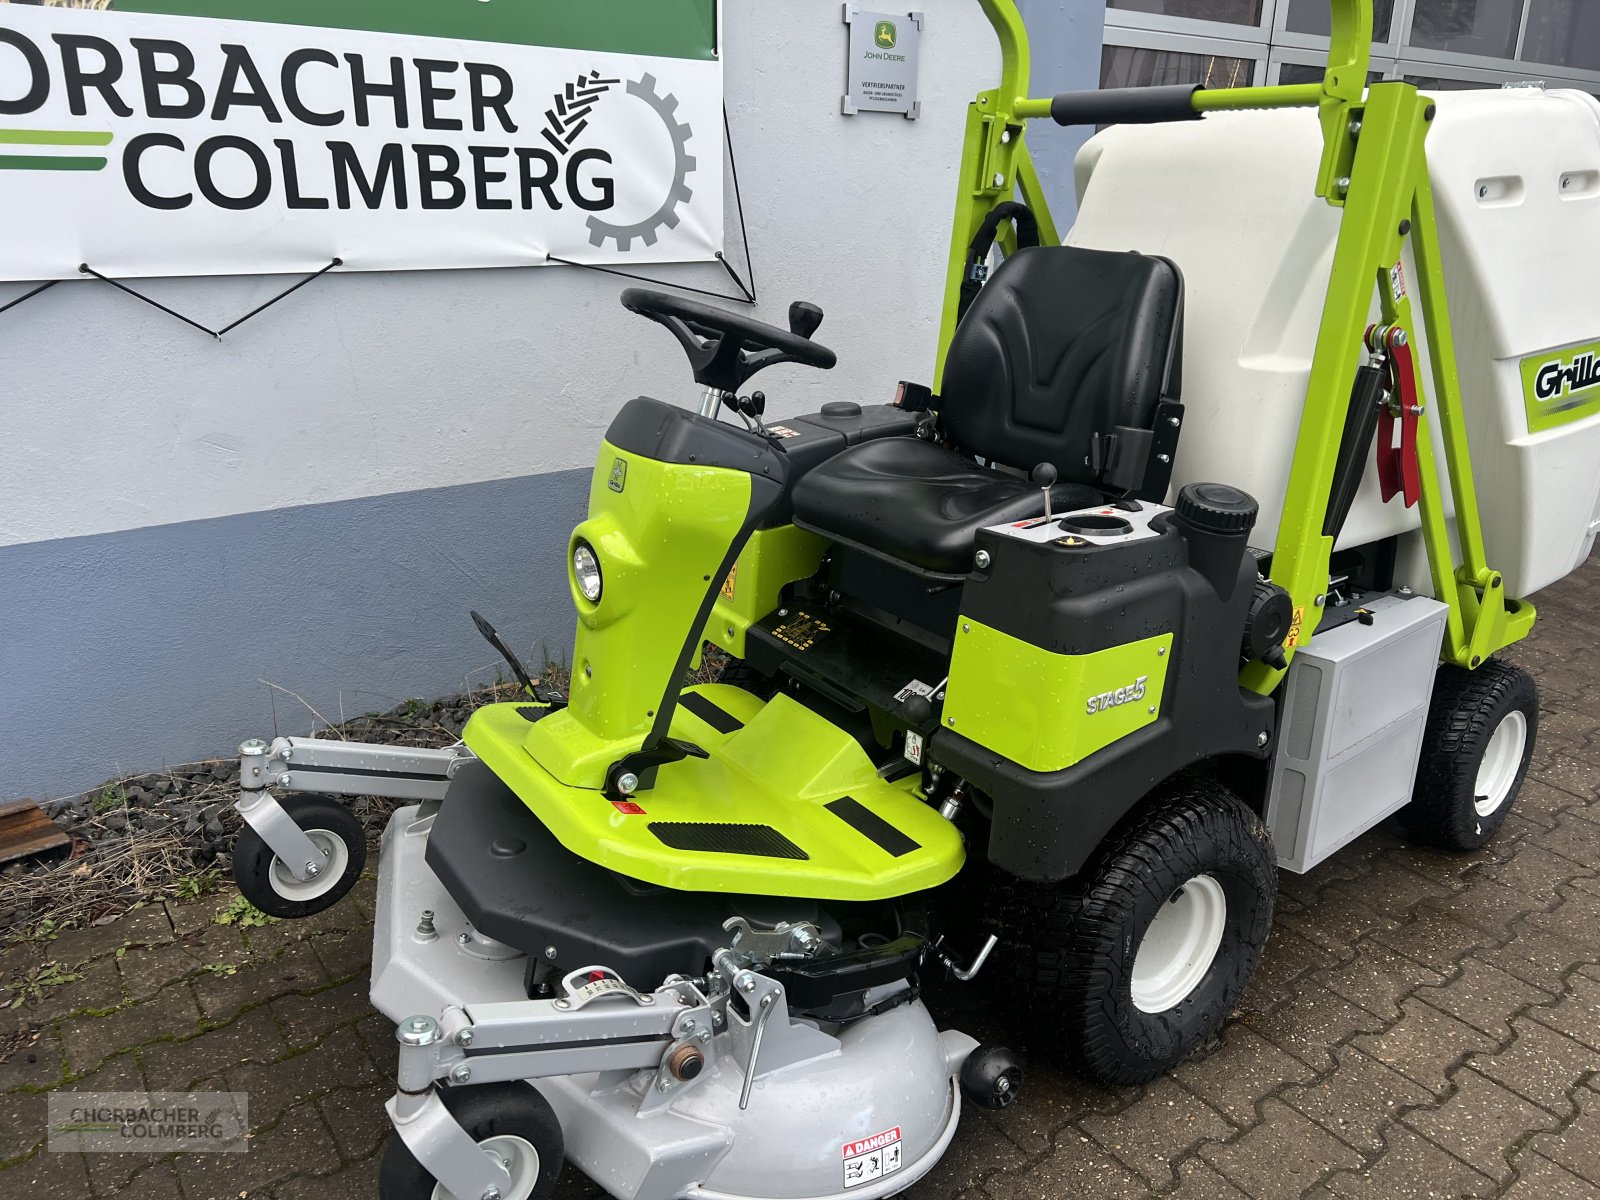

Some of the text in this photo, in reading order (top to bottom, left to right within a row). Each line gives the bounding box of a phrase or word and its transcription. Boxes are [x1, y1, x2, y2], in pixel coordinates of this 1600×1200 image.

[863, 51, 905, 62] JOHN DEERE
[861, 81, 905, 90] VERTRIEBSPARTNER
[122, 133, 615, 212] COLMBERG
[855, 1130, 897, 1154] DANGER
